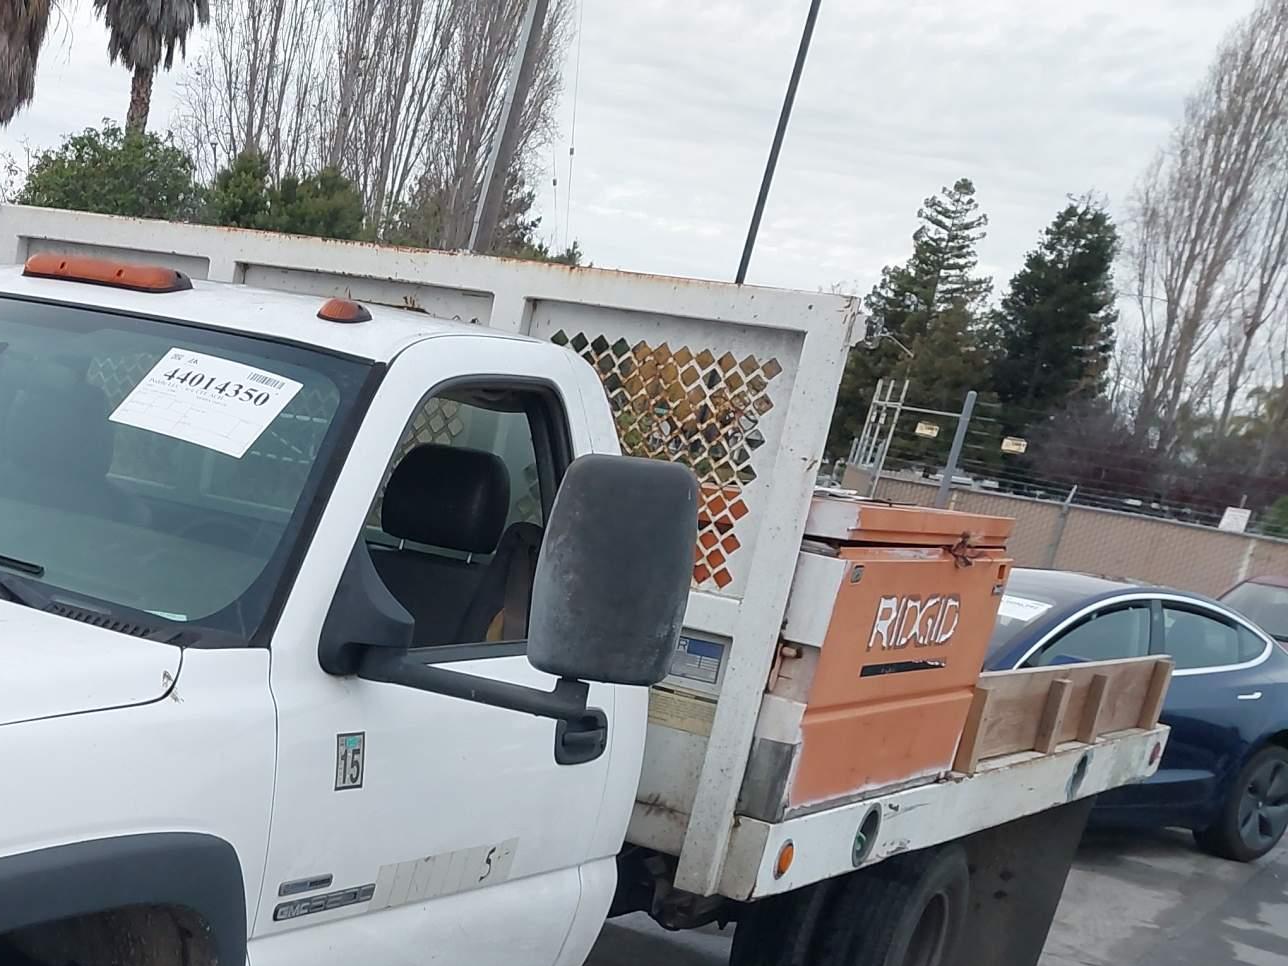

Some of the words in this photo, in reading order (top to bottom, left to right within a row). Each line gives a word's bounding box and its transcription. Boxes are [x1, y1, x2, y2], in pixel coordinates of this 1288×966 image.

[163, 367, 271, 407] 44014350
[867, 593, 960, 651] RIDGID
[341, 749, 361, 784] 15
